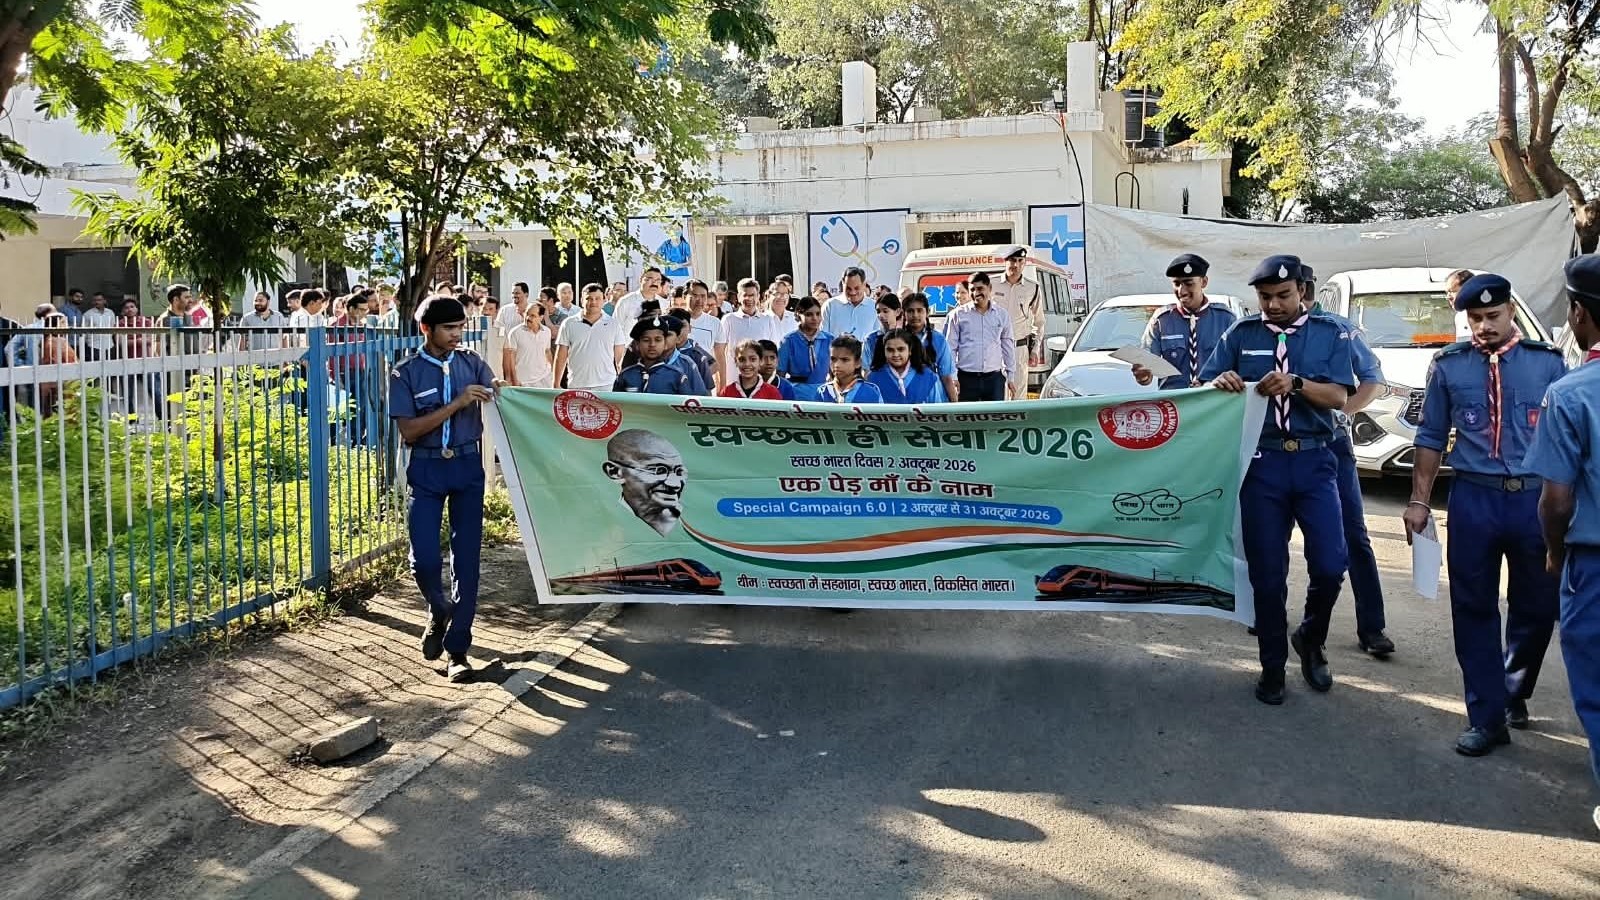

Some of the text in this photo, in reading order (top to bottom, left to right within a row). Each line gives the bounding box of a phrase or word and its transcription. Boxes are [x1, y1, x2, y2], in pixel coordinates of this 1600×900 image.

[938, 255, 992, 266] AMBULANCE
[912, 407, 948, 422] रेल
[687, 423, 1093, 460] स्वच्छता ही सेवा 2026
[790, 452, 976, 473] स्वच्छ भारत दिवस 2 अक्टूबर 2026
[779, 472, 993, 498] एक पेड़ माँ के नाम
[733, 502, 785, 515] Special
[789, 502, 861, 515] Campaign
[866, 502, 887, 513] 6.0
[901, 503, 908, 513] 2
[911, 502, 948, 516] अक्टूबर
[951, 502, 961, 514] से
[963, 505, 976, 515] 31
[980, 505, 1017, 520] अक्टूबर
[1021, 509, 1050, 520] 2026
[737, 574, 759, 588] थीम
[767, 578, 806, 590] स्वच्छता
[867, 579, 896, 591] स्वच्छ
[934, 575, 978, 592] विकसित
